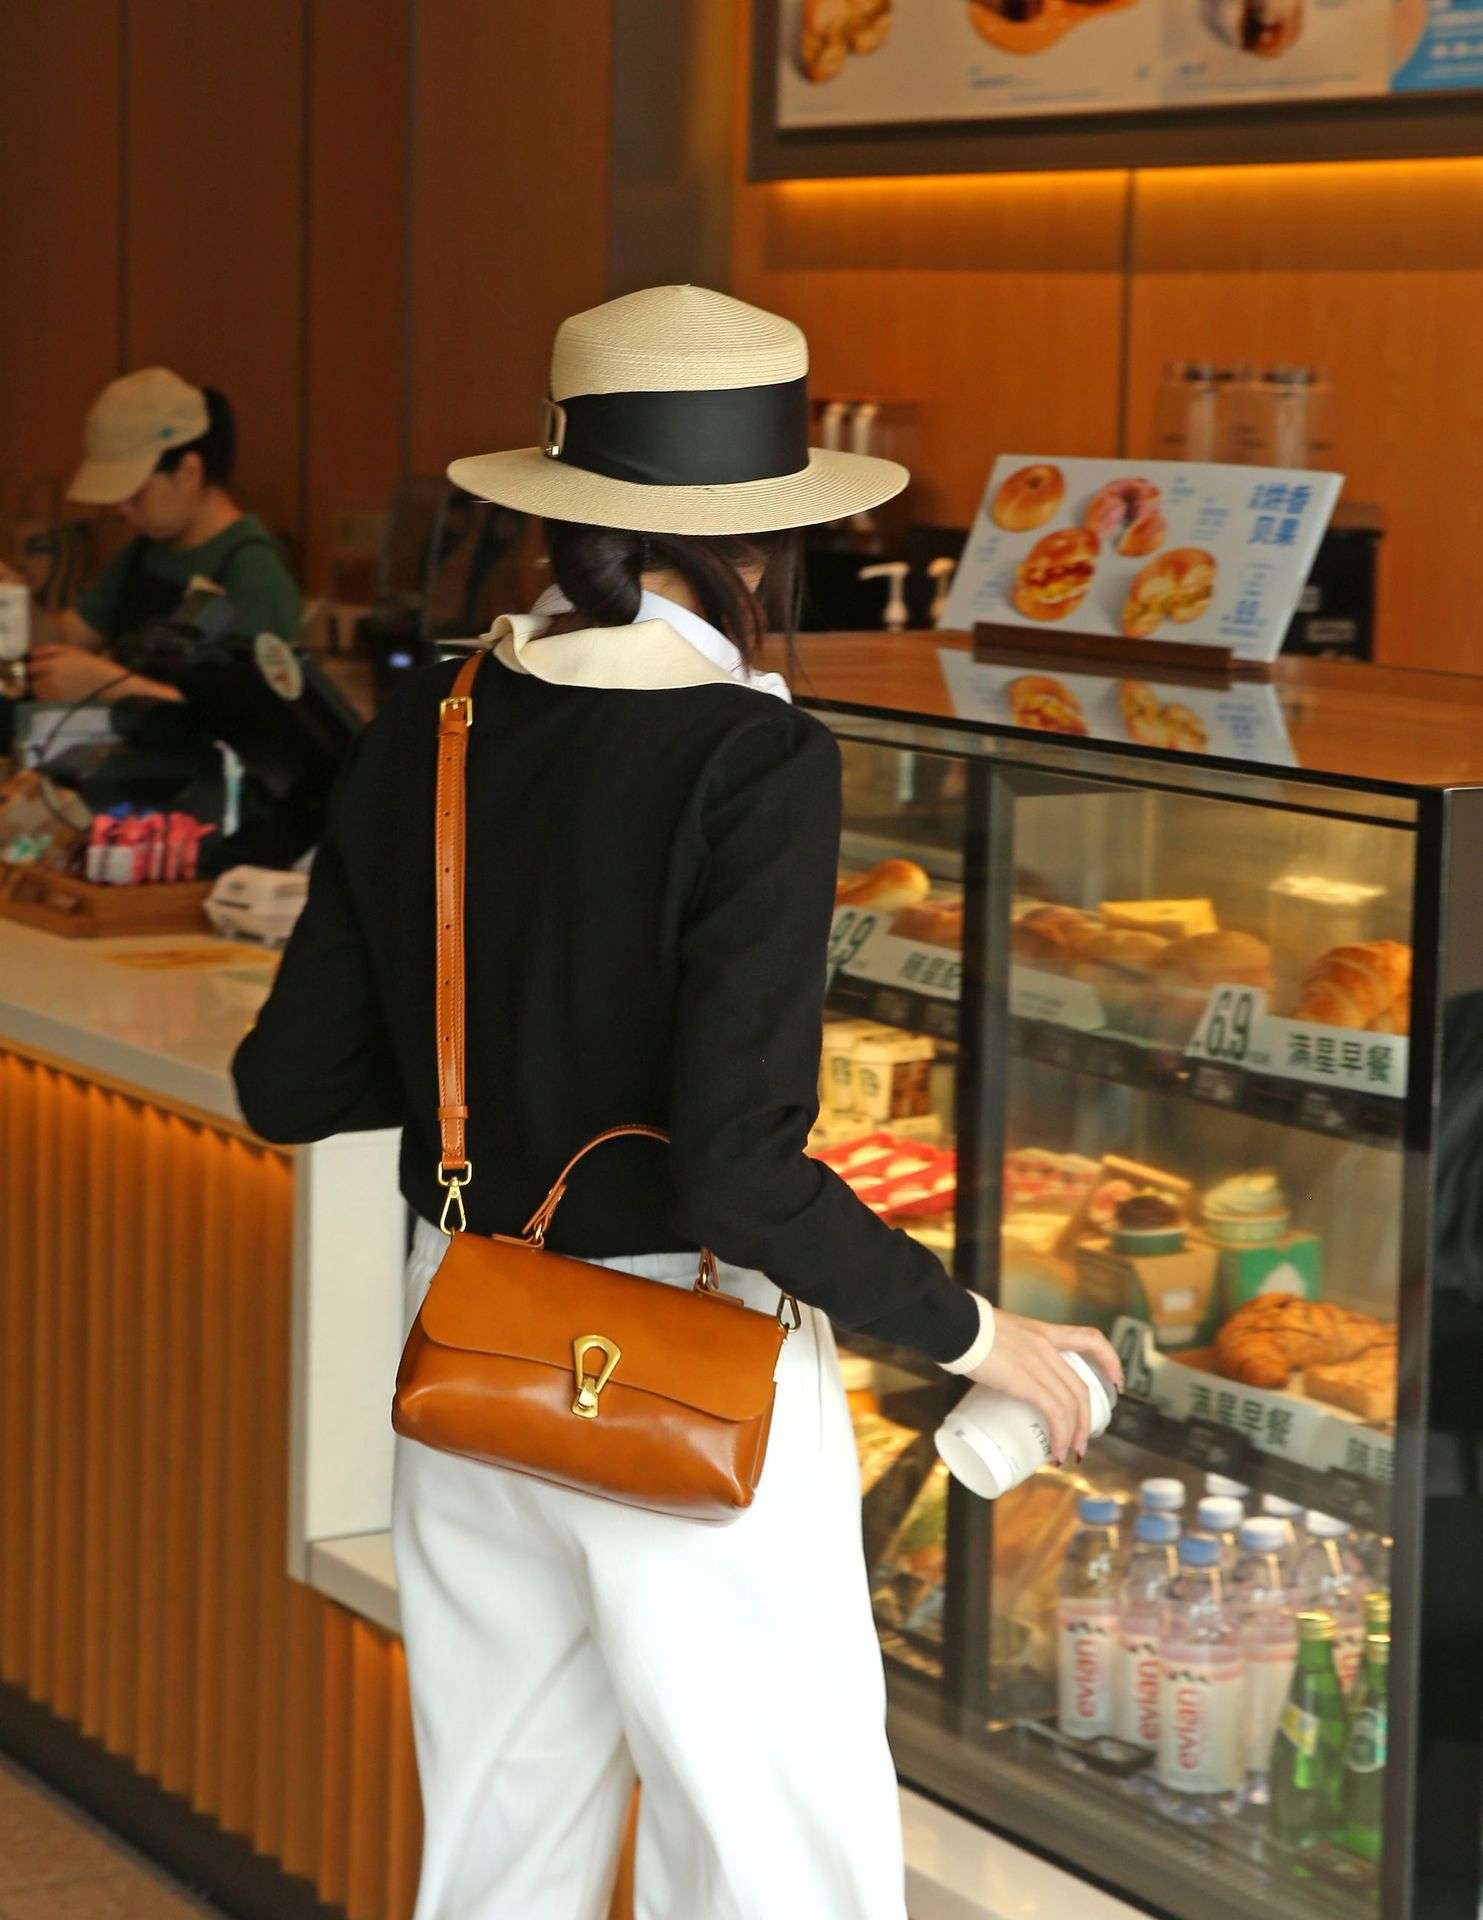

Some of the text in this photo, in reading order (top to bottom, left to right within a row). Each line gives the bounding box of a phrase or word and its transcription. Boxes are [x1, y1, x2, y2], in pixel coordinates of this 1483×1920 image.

[1074, 1637, 1098, 1718] evian
[1138, 1659, 1162, 1741] evian
[1175, 1686, 1199, 1770] evian
